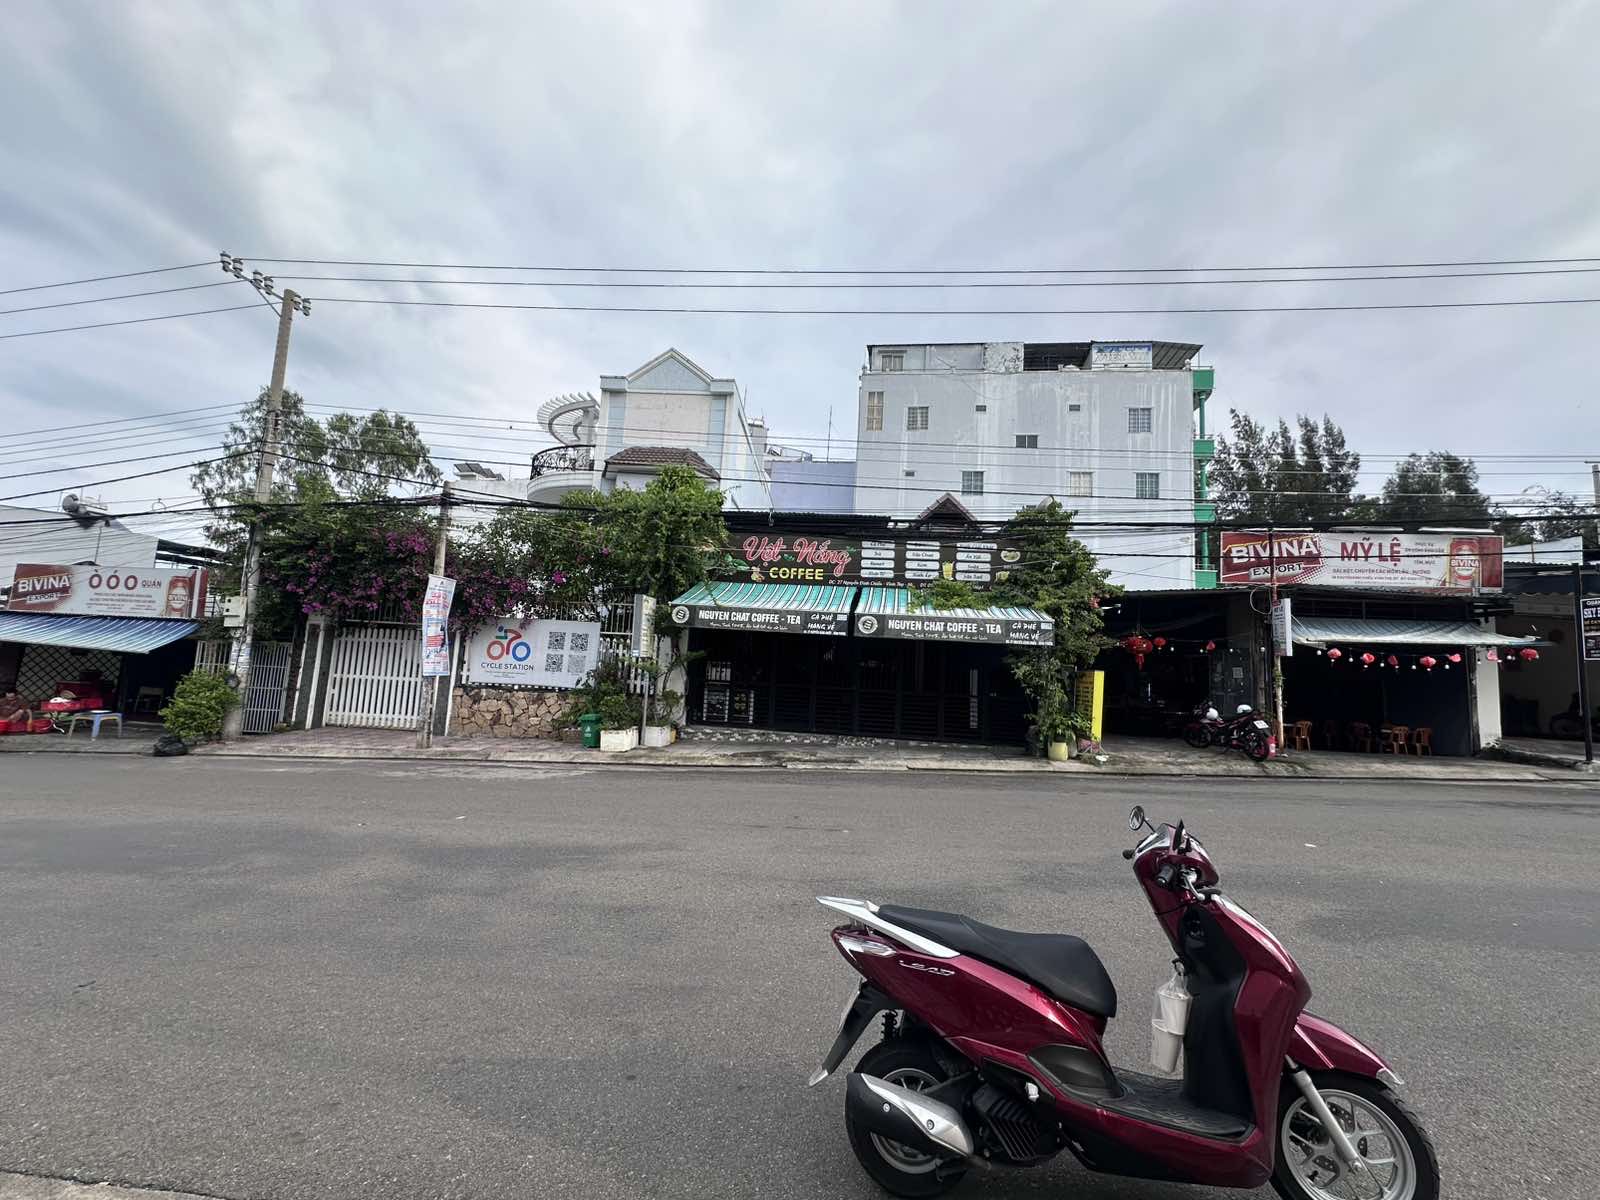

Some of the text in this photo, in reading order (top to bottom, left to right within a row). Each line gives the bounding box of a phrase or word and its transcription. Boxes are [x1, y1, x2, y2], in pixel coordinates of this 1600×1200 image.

[1231, 537, 1319, 564] BIVINA
[1340, 536, 1401, 567] MỸ LỆ
[769, 567, 824, 580] COFFEE
[1253, 564, 1304, 576] EXORT
[18, 575, 71, 593] BIVINA
[699, 610, 730, 621] NGUYEN
[731, 611, 751, 622] CHAT
[751, 613, 780, 624] COFFEE
[786, 614, 801, 625] TEA
[888, 619, 922, 631] NGUYEN
[924, 621, 945, 632] CHAT
[946, 622, 978, 633] COFFEE
[985, 623, 1002, 634] TEA
[480, 661, 535, 671] CYCLE STATION
